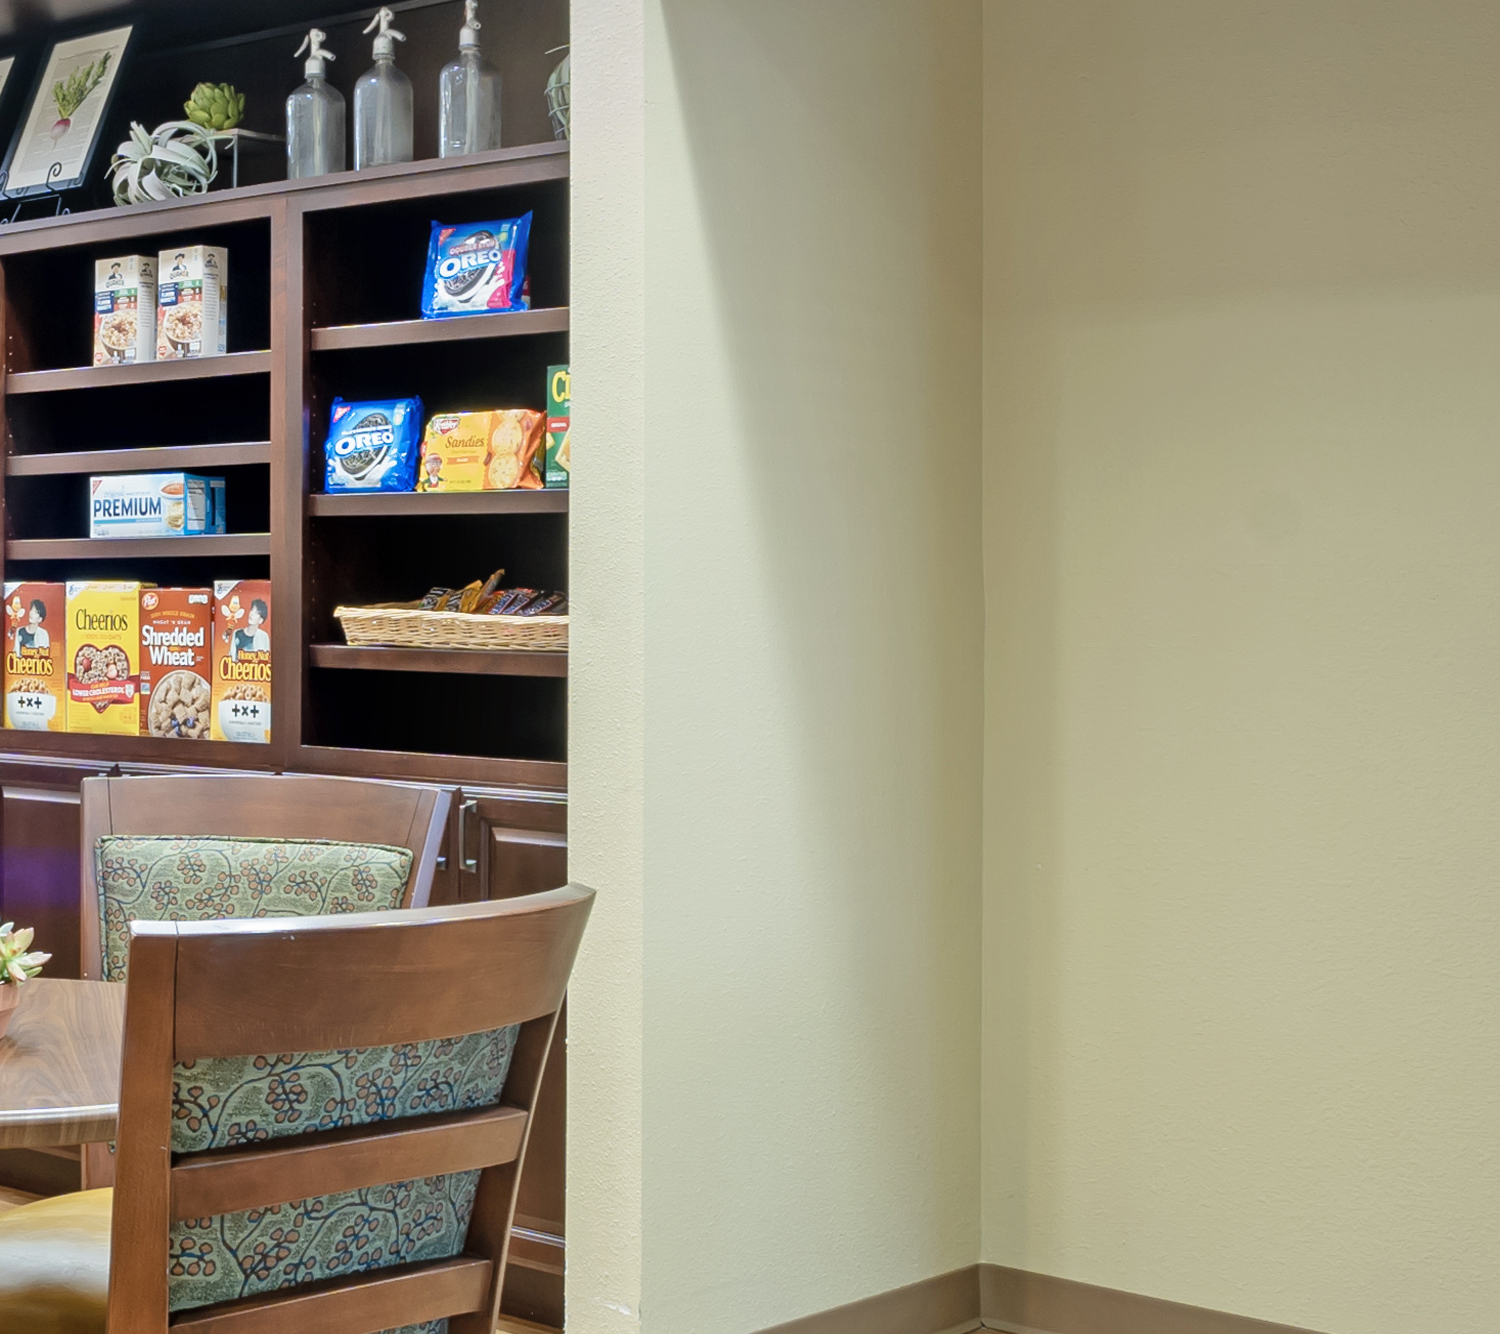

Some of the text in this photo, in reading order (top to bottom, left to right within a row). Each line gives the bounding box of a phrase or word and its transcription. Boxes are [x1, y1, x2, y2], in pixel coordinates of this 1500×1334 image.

[439, 250, 501, 278] OREO
[335, 432, 394, 456] OREO
[445, 435, 485, 449] Sandies
[94, 497, 162, 517] PREMIUM
[76, 608, 128, 631] Cheerios
[142, 624, 205, 647] Shredded
[6, 652, 53, 676] Cheerios
[21, 647, 38, 659] Honey
[149, 645, 195, 666] Wheat
[238, 650, 257, 663] Honey
[220, 655, 271, 681] Cheerios
